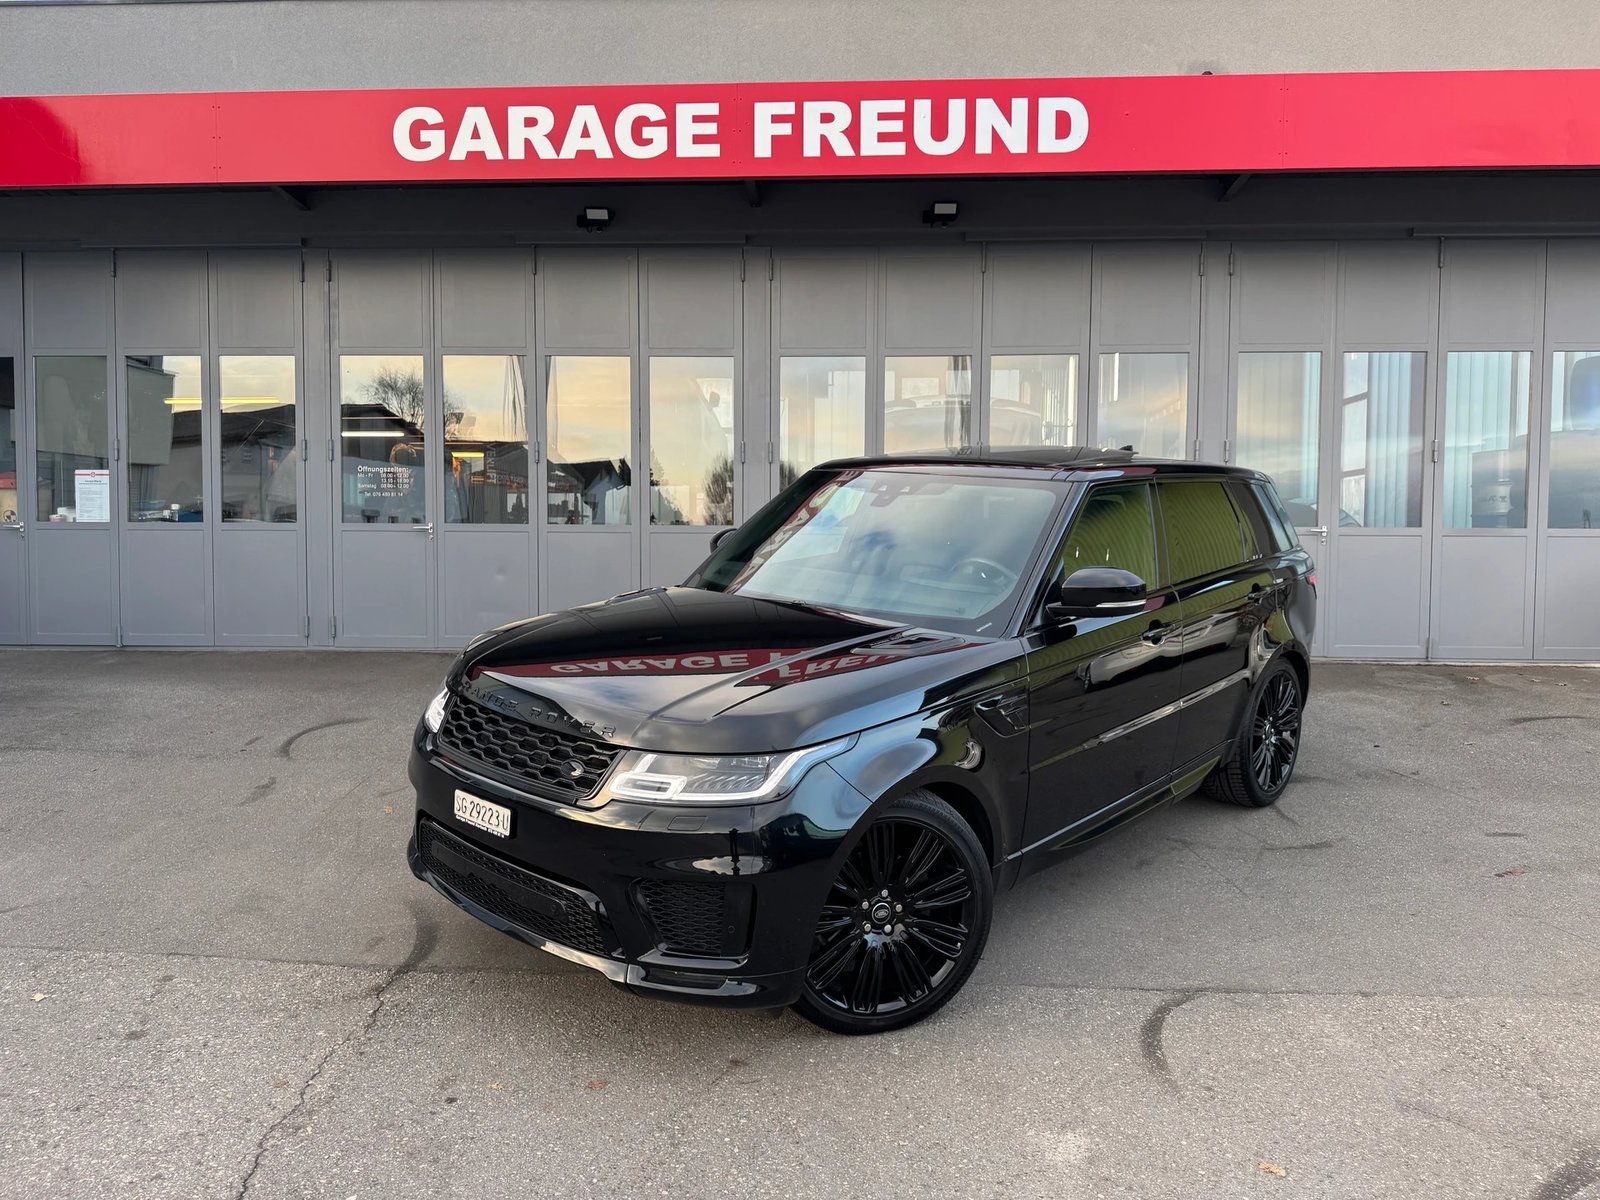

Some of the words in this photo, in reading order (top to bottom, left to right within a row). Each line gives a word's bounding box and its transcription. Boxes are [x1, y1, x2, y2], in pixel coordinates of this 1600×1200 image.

[393, 103, 721, 162] GARAGE
[754, 97, 1089, 157] FREUND
[357, 465, 409, 473] Öffnungszeiten:
[530, 706, 616, 738] ROVER
